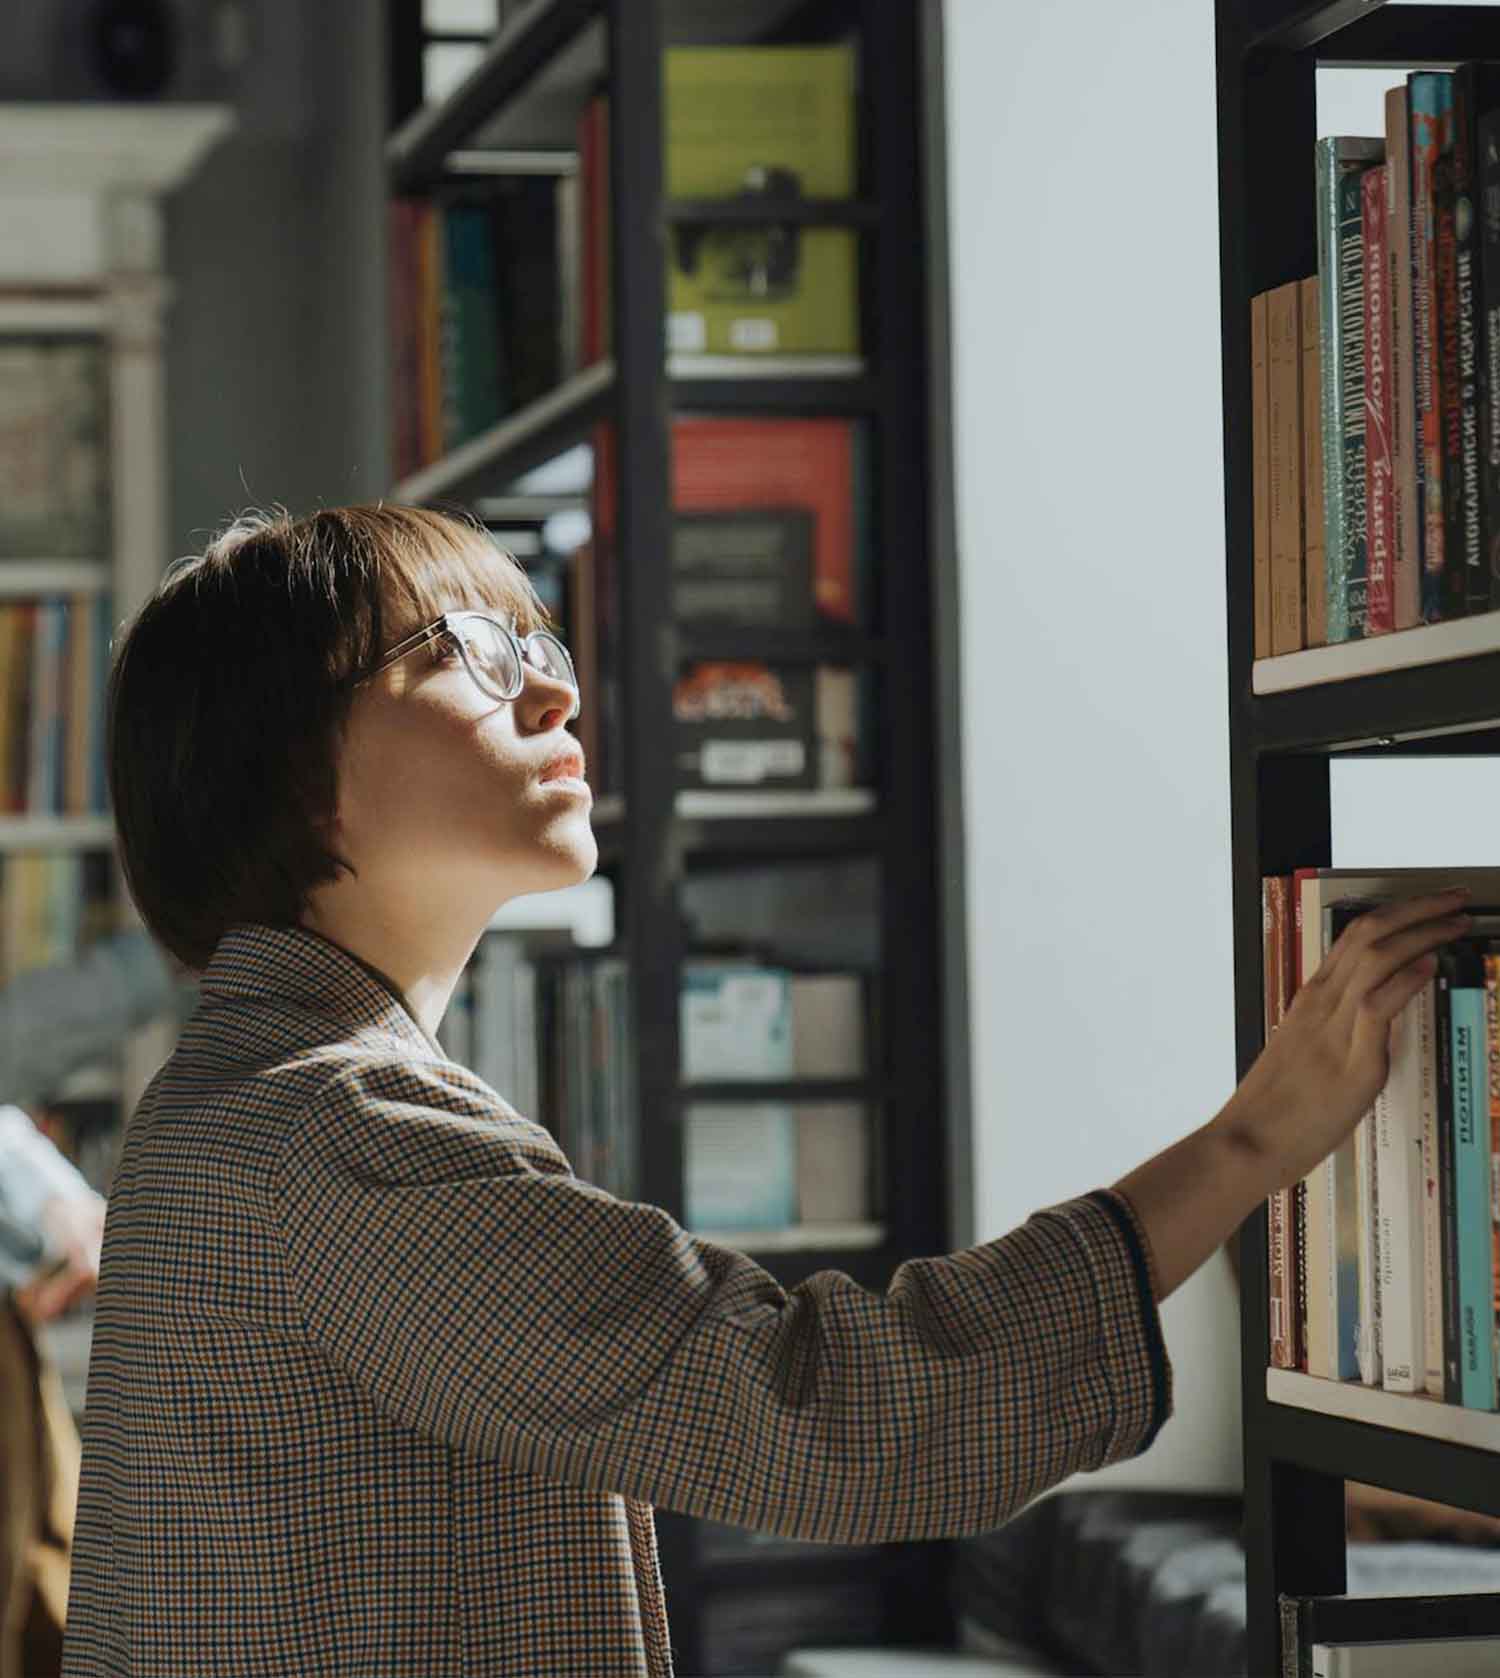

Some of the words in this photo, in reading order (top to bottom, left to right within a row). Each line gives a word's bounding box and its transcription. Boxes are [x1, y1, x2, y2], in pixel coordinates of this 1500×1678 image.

[1341, 234, 1366, 440] ИМПРЕССИОНИСТОВ
[1457, 251, 1473, 378] ИСКУССТВЕ
[1353, 444, 1367, 542] ЖИЗНЬ
[1370, 458, 1387, 584] Братья
[1462, 408, 1480, 568] АПОКАЛИПСИС
